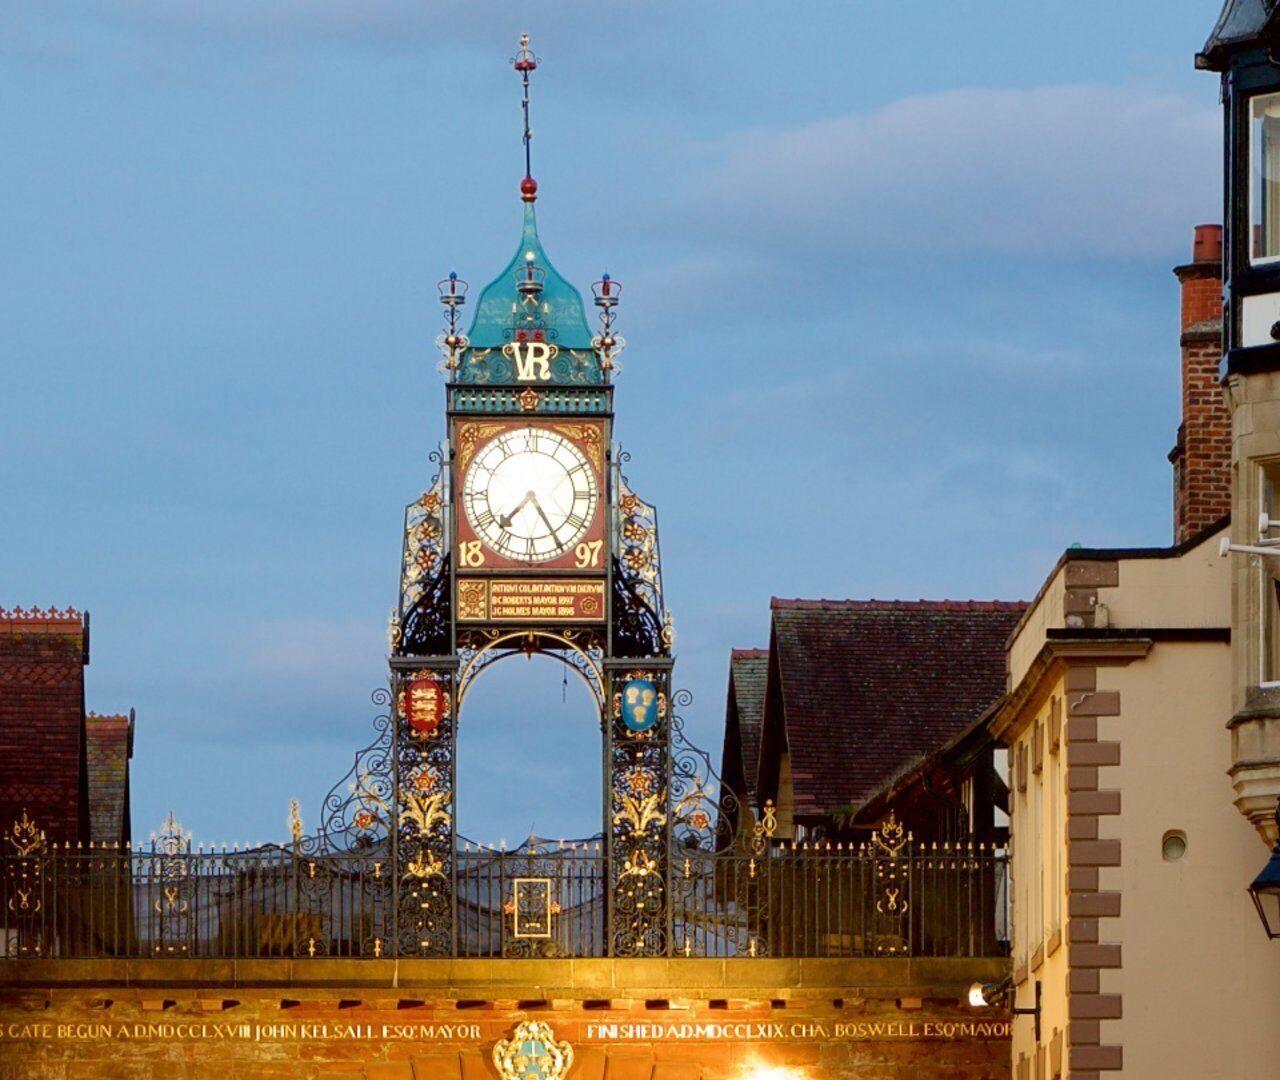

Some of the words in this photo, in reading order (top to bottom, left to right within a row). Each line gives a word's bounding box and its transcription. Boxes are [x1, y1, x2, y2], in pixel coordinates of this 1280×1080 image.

[459, 540, 485, 567] 18
[574, 539, 603, 568] 97
[533, 596, 557, 605] MAYOR
[532, 607, 556, 616] MAYOR
[8, 1023, 52, 1038] GATE
[57, 1023, 113, 1038] BEGUN
[255, 1024, 297, 1041] JOHN
[301, 1024, 378, 1039] KELSALL
[420, 1024, 481, 1039] MAYOR
[587, 1024, 663, 1038] FINISHED
[835, 1023, 919, 1037] BOSWELL
